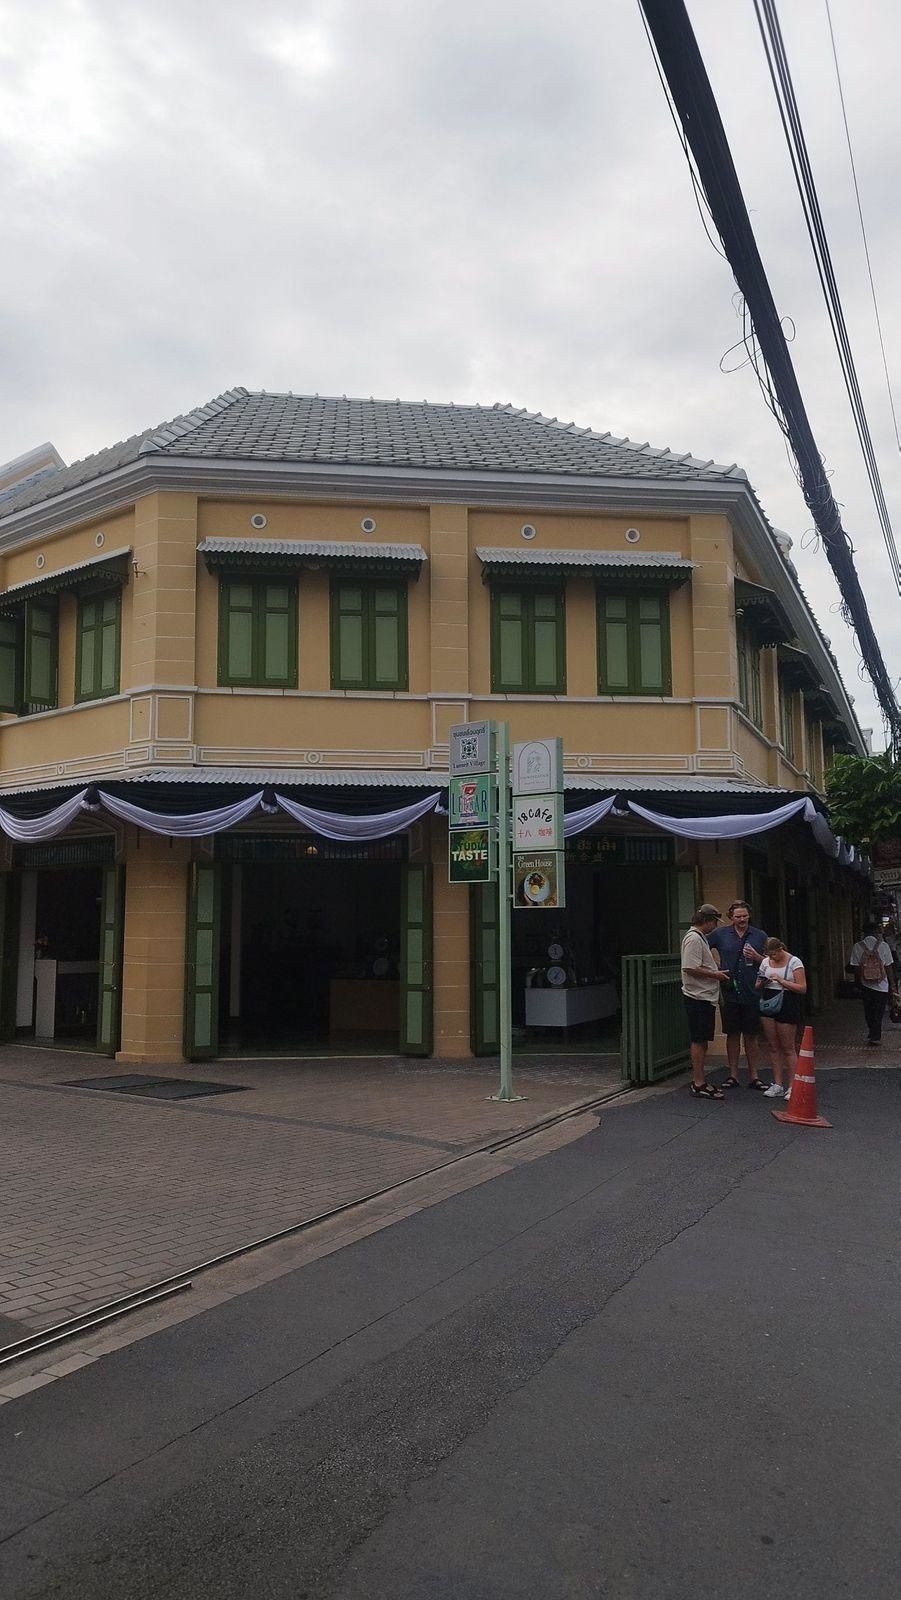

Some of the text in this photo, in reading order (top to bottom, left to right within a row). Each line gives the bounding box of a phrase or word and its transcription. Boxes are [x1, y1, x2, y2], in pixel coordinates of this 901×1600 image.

[451, 849, 488, 862] TASTE
[517, 859, 553, 868] Green House
